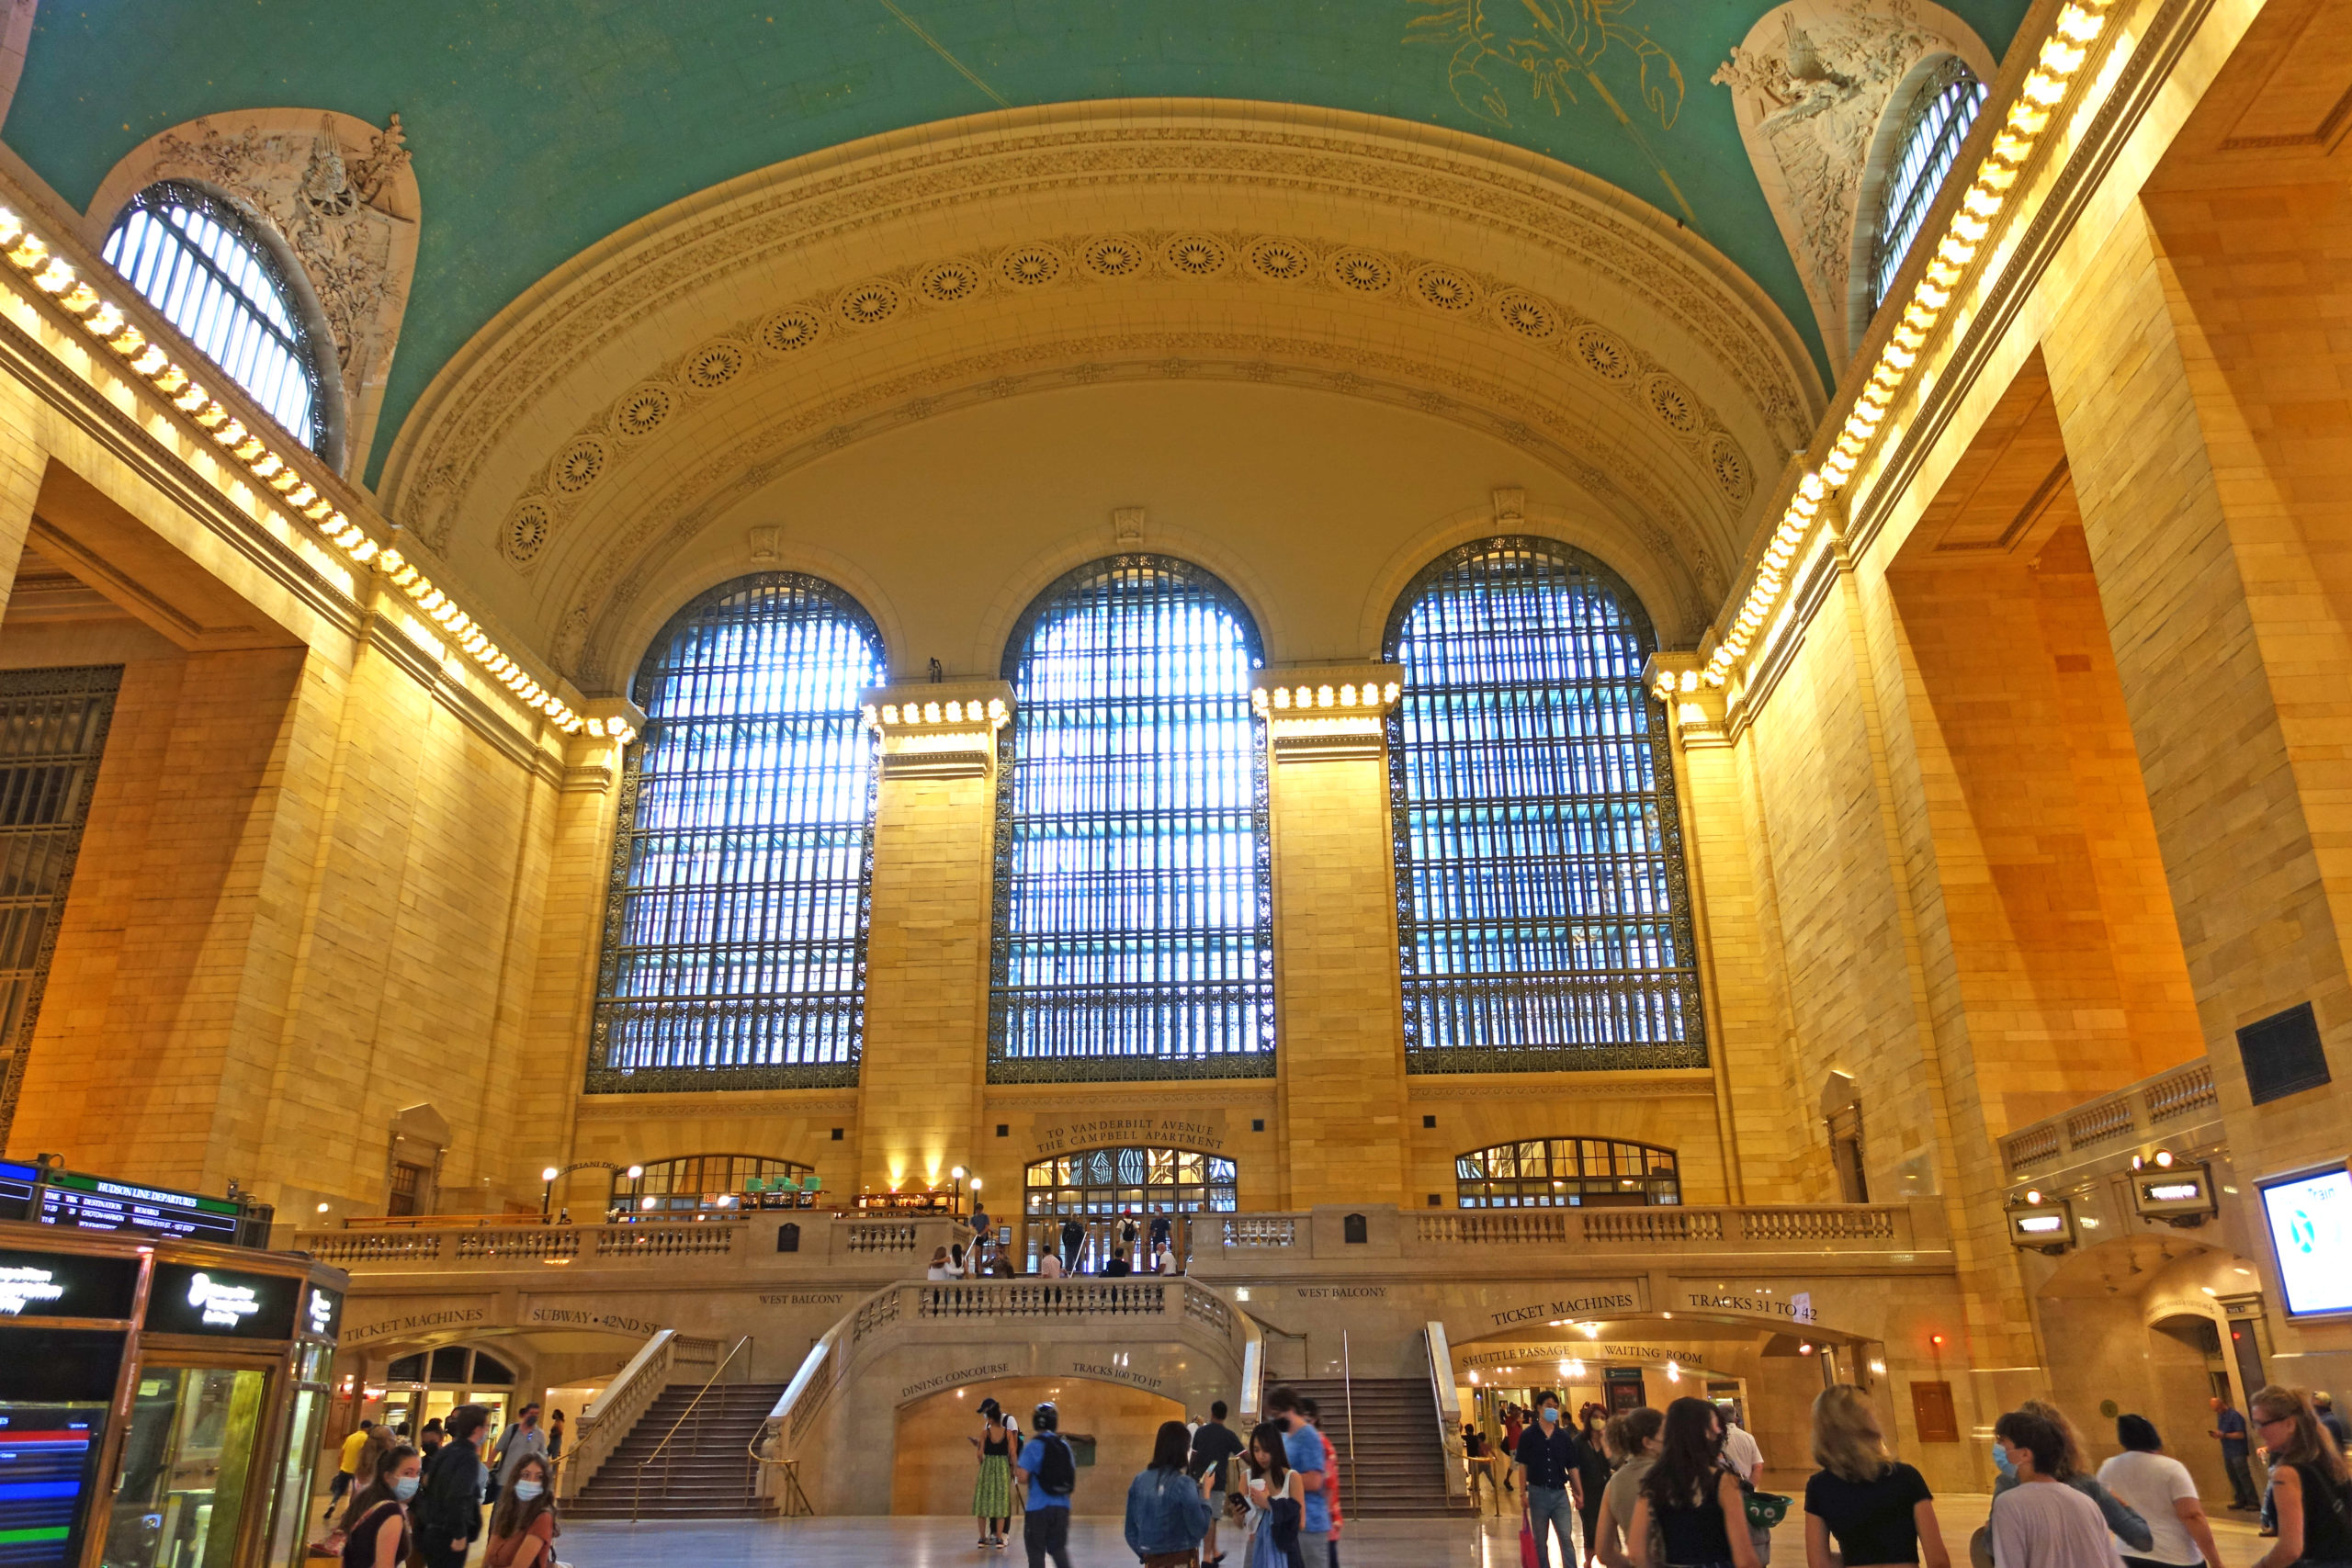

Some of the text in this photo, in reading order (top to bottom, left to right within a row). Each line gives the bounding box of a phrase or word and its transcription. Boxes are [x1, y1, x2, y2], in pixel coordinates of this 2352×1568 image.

[1046, 1120, 1214, 1139] TO VANDERBILT AVENUE
[1036, 1131, 1224, 1153] THE CAMPBELL APARTMENT
[44, 1191, 61, 1201] TIME
[83, 1197, 123, 1211] DESTINATION
[134, 1205, 160, 1216] REMARKS
[97, 1181, 198, 1207] HUDSON LINE DEPARTURES
[759, 1293, 843, 1304] WEST BALCONY
[1297, 1287, 1386, 1297] WEST BALCONY
[1492, 1294, 1634, 1326] TICKET MACHINES
[1689, 1294, 1817, 1321] TRACKS 31 TO 42
[345, 1308, 483, 1342] TICKET MACHINES
[533, 1308, 593, 1325] SUBWAY
[602, 1315, 640, 1332] 42ND
[1462, 1345, 1570, 1367] SHUTTLE PASSAGE
[1604, 1345, 1702, 1364] WAITING ROOM
[902, 1362, 1010, 1398] DINING CONCOURSE
[1073, 1362, 1162, 1389] TRACKS 100 TO 117
